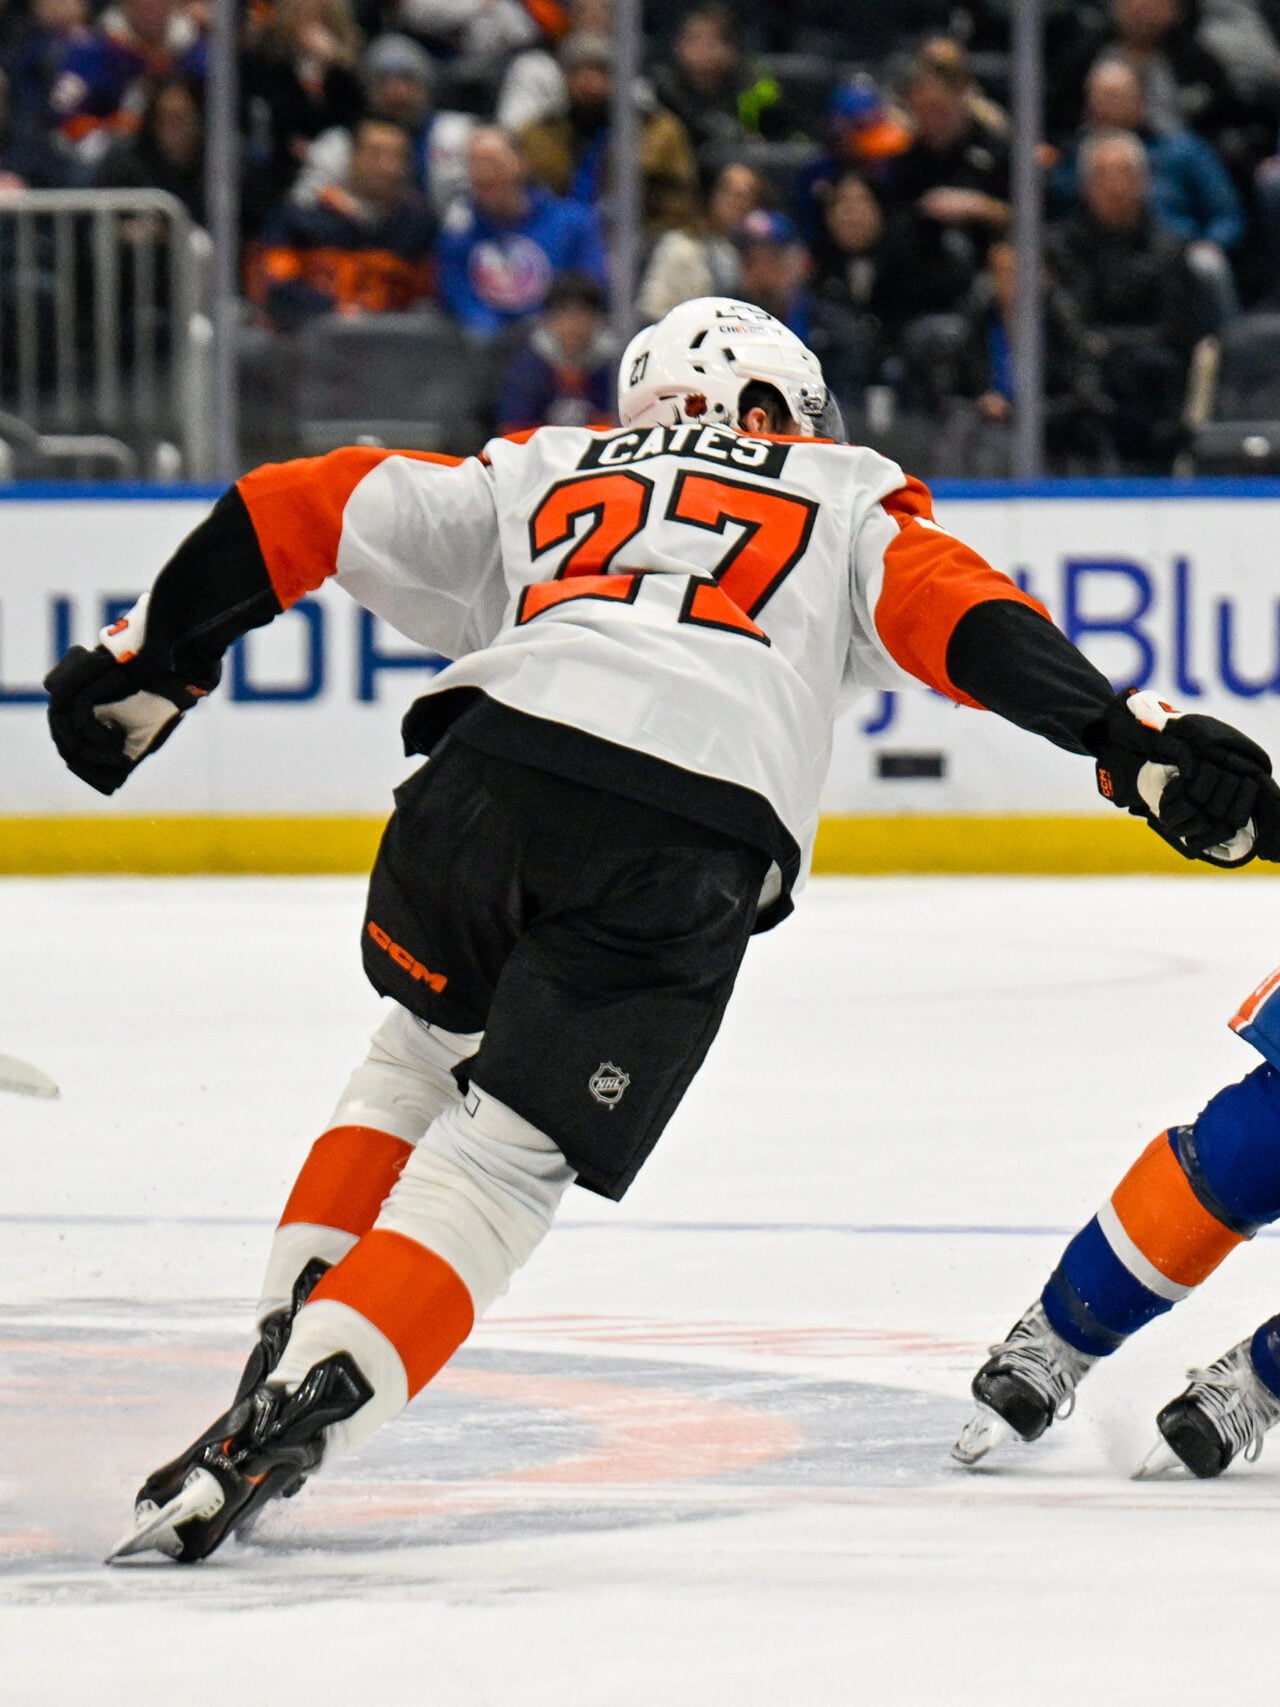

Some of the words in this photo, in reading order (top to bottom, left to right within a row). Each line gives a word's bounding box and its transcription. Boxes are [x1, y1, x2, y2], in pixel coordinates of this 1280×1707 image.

[629, 350, 650, 387] 27
[597, 424, 772, 468] CATES
[514, 468, 820, 648] 27
[367, 920, 448, 993] CCM
[595, 1078, 621, 1090] NHL
